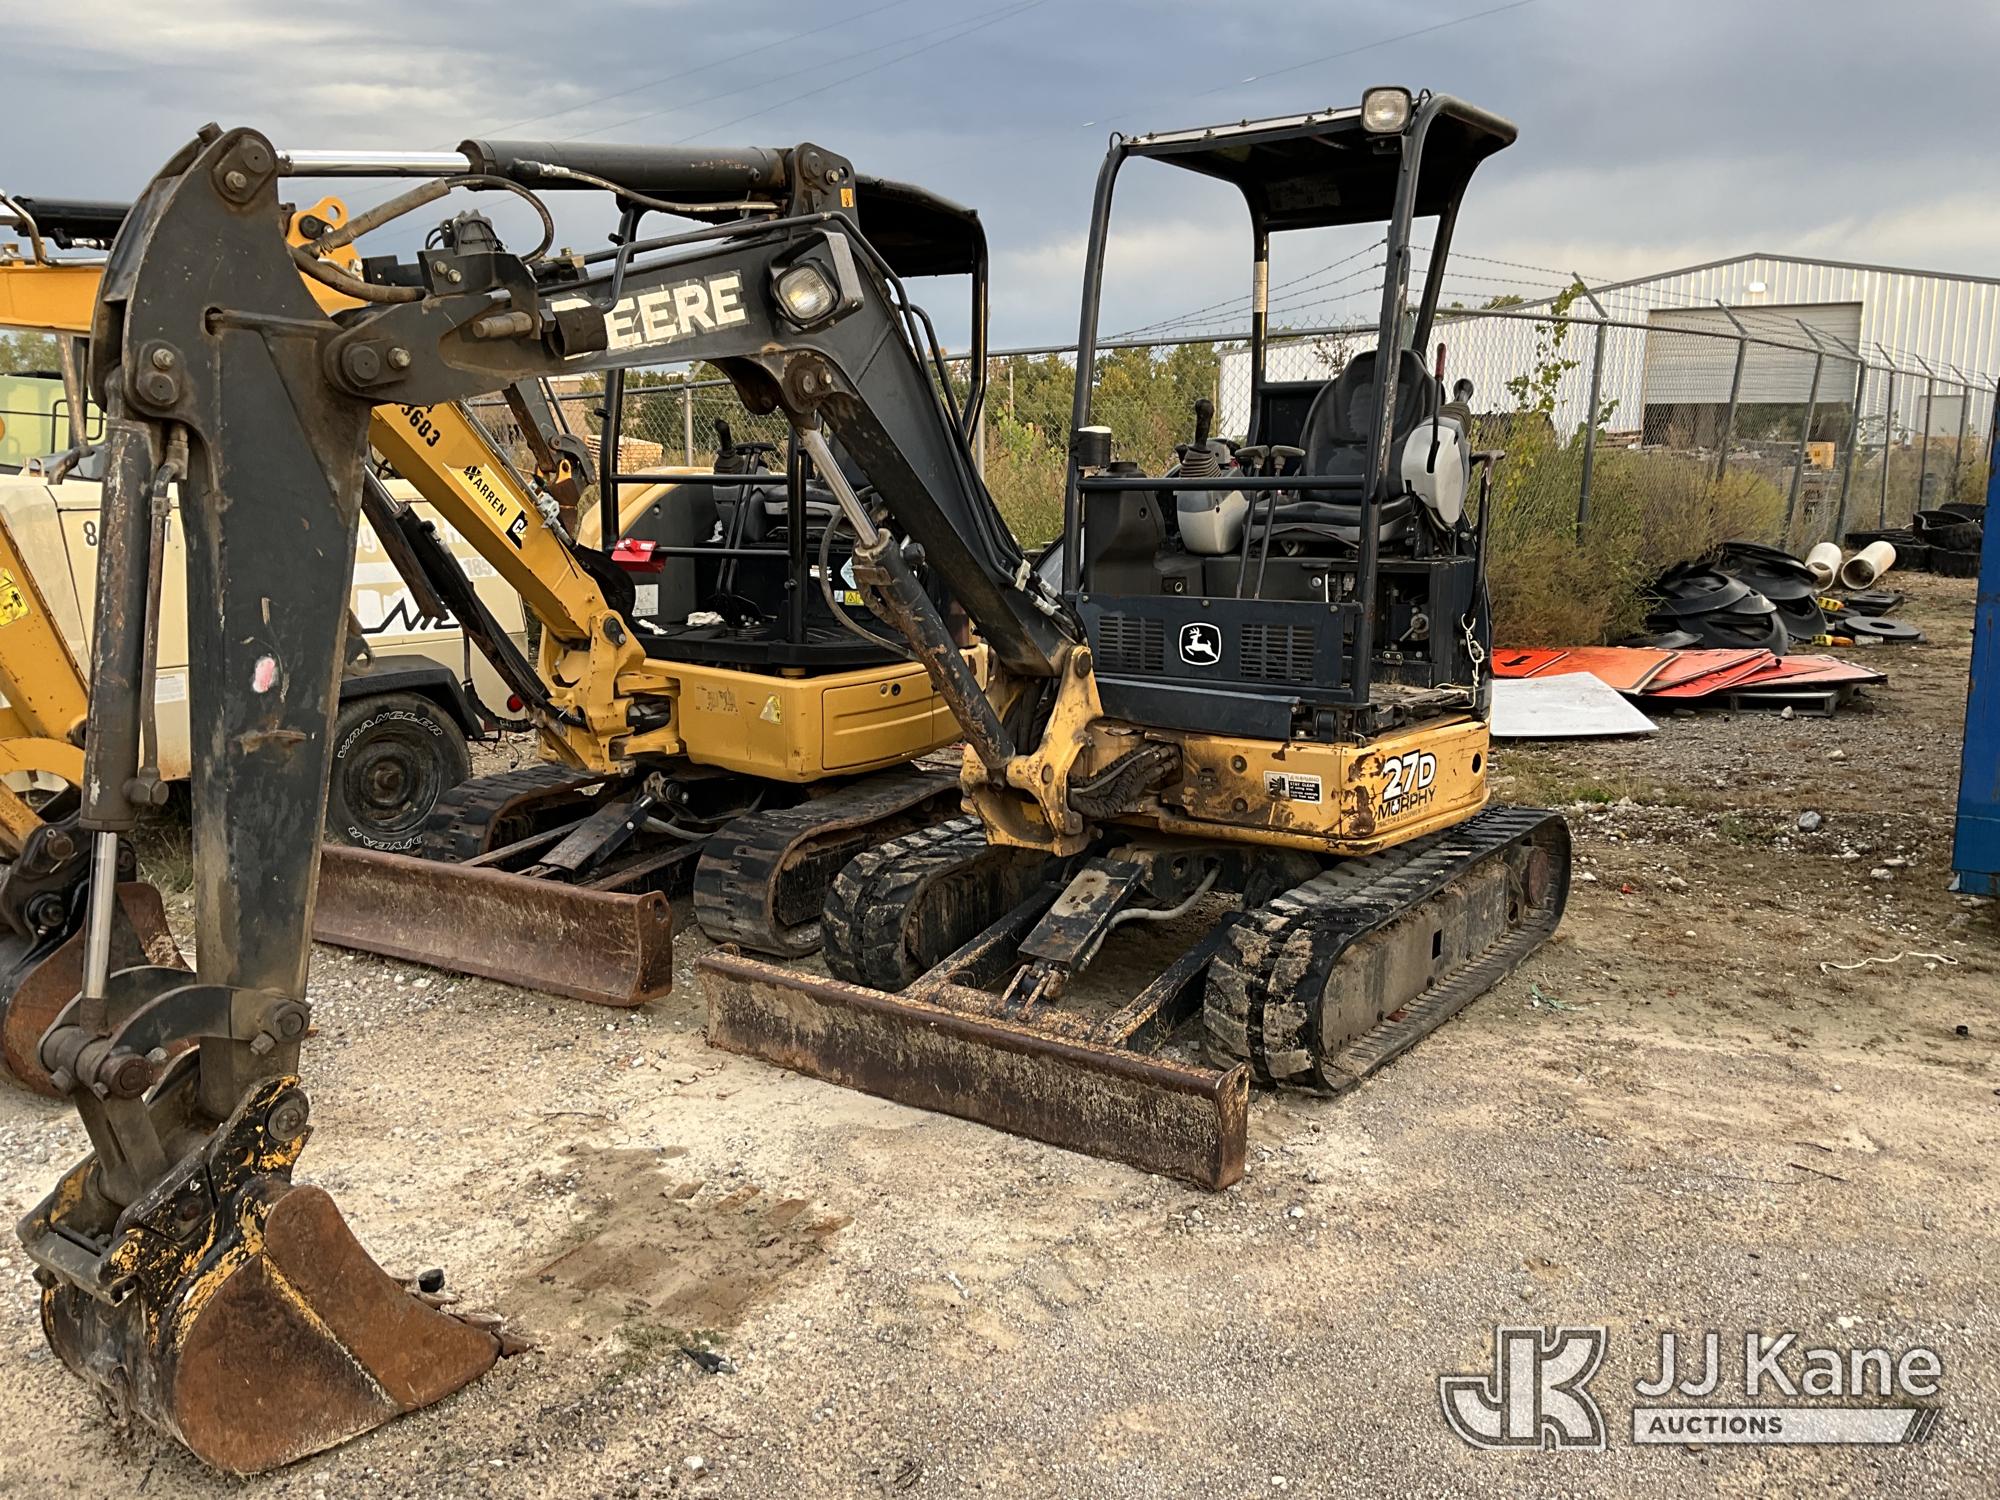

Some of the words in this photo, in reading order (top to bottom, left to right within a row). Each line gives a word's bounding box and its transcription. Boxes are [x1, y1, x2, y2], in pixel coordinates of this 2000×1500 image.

[337, 710, 444, 759] WRANGLER
[1382, 749, 1437, 804] 27D
[1377, 786, 1437, 821] MURPHY
